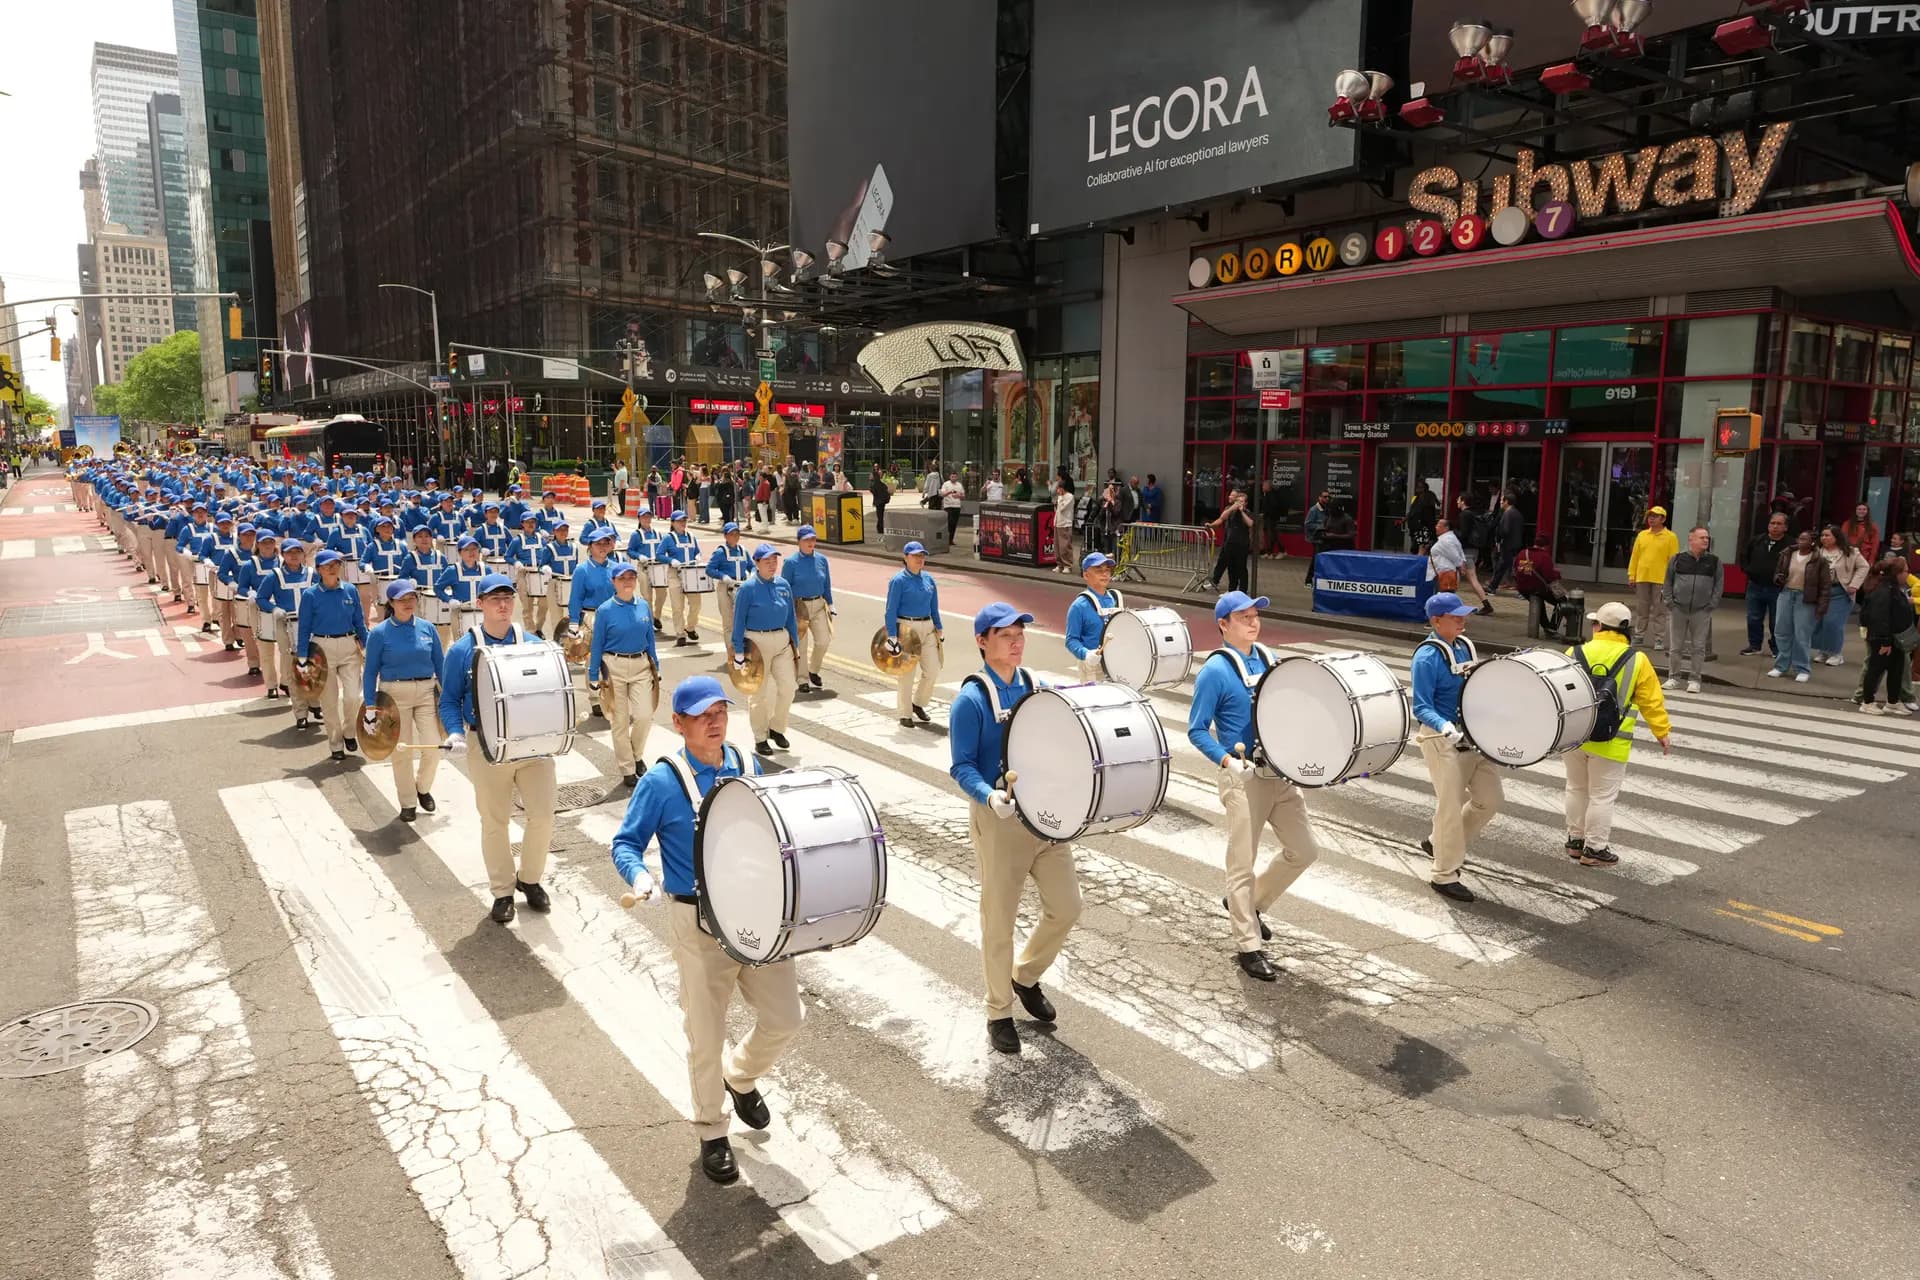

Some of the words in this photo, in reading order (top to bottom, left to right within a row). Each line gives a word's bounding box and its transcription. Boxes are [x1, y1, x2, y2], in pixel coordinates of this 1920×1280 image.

[1088, 65, 1269, 163] LEGORA
[1086, 164, 1142, 188] Collaborative
[1144, 160, 1154, 174] AI
[1155, 158, 1170, 172] for
[1170, 141, 1227, 168] exceptional
[1228, 132, 1270, 155] lawyers
[1405, 119, 1792, 234] Subway
[1220, 259, 1234, 276] N
[1250, 252, 1265, 273] Q
[1279, 248, 1293, 268] R
[1306, 244, 1332, 268] W
[1345, 237, 1361, 259] S
[1419, 226, 1435, 251] 2
[1457, 219, 1474, 245] 3
[1545, 206, 1562, 233] 7
[926, 333, 1010, 366] LOFT
[1344, 431, 1366, 439] Subway
[1367, 431, 1388, 439] Station
[1382, 423, 1390, 431] St
[1328, 581, 1357, 592] TIMES
[1359, 585, 1403, 596] SQUARE
[1040, 816, 1058, 828] REMO
[740, 935, 758, 947] REMO
